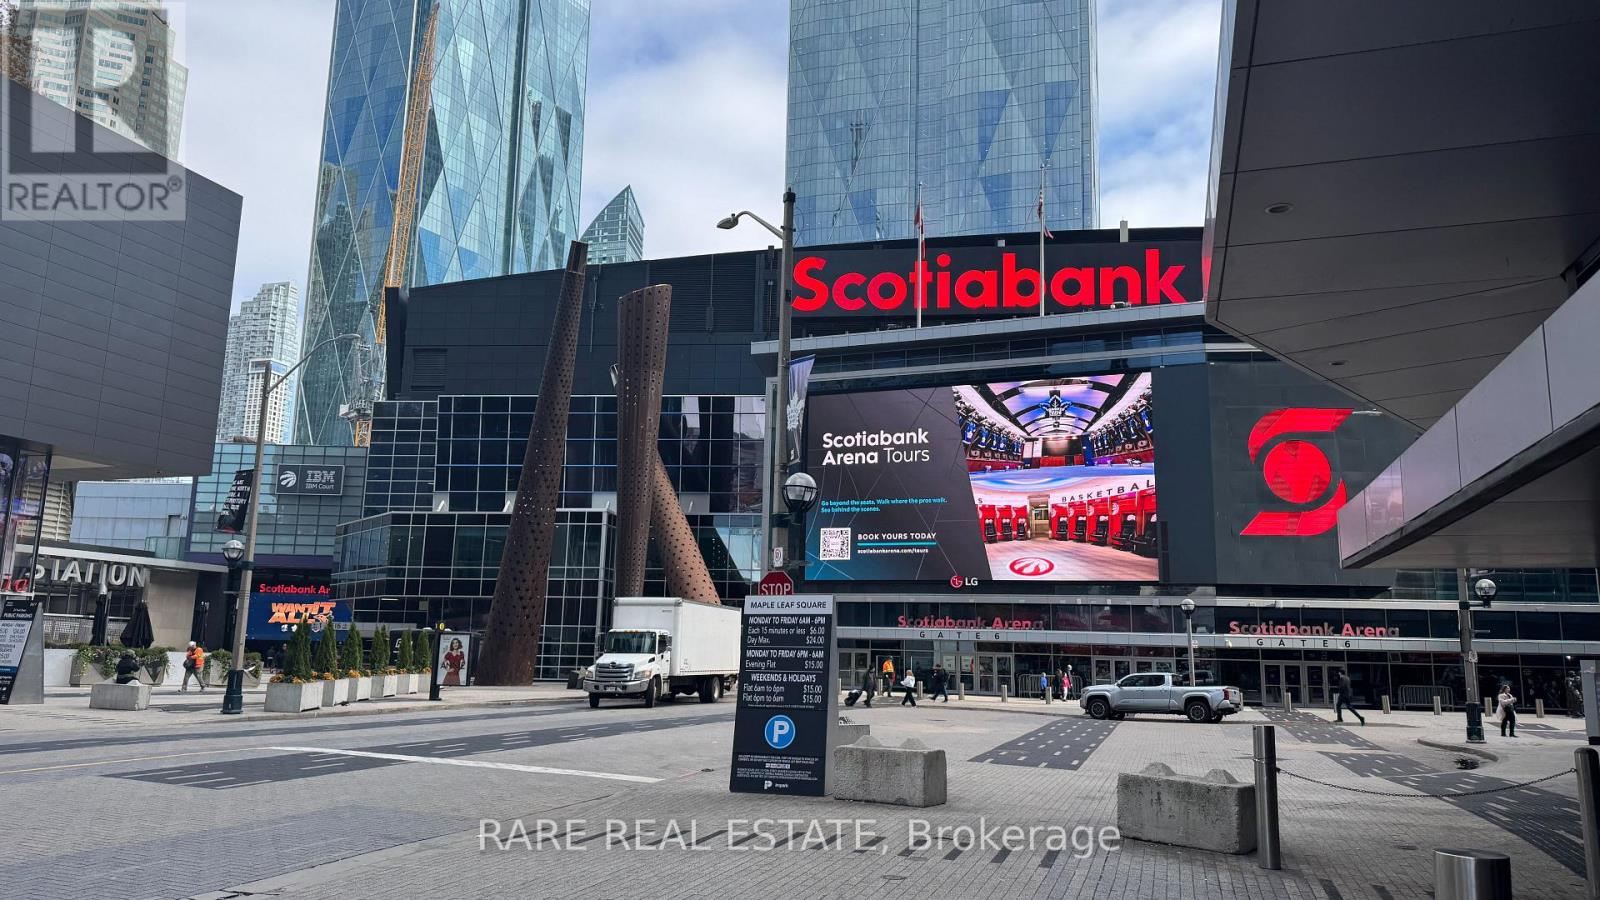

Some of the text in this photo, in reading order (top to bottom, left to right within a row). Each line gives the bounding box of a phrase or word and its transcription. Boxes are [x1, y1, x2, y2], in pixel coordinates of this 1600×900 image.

[791, 249, 1188, 312] Scotiabank
[822, 428, 929, 448] Scotiabank
[822, 447, 930, 466] Arena Tours
[306, 470, 335, 483] IBM
[829, 499, 850, 507] beyond
[857, 533, 879, 541] BOOK
[964, 577, 979, 586] LG
[259, 584, 316, 594] Scotiabank
[761, 583, 791, 595] STOP
[750, 601, 827, 609] MAPLE LEAF SQUARE
[748, 616, 772, 625] MONDAY
[772, 616, 780, 624] TO
[780, 616, 799, 625] FRIDAY
[799, 616, 811, 625] 6AM
[814, 616, 826, 625] 6PM
[897, 615, 1044, 630] Scotiabank Arena
[747, 626, 760, 635] Each
[761, 626, 768, 634] 15
[768, 627, 789, 635] minutes
[796, 627, 806, 635] less
[809, 626, 825, 636] $6.00
[1229, 620, 1400, 637] Scotiabank Arena
[747, 636, 825, 646] Day Max. $24.00
[746, 649, 770, 658] MONDAY
[769, 650, 778, 658] TO
[777, 650, 797, 658] FRIDAY
[796, 650, 809, 658] 6PM
[811, 650, 824, 659] 6AM
[745, 660, 824, 670] Evening Flat $15.00
[750, 673, 817, 683] WEEKENDS & HOLIDAYS
[743, 683, 823, 696] Flat 6am to 6pm $15.00
[742, 692, 822, 704] Flat 6pm to 6am $15.00
[772, 720, 790, 743] P
